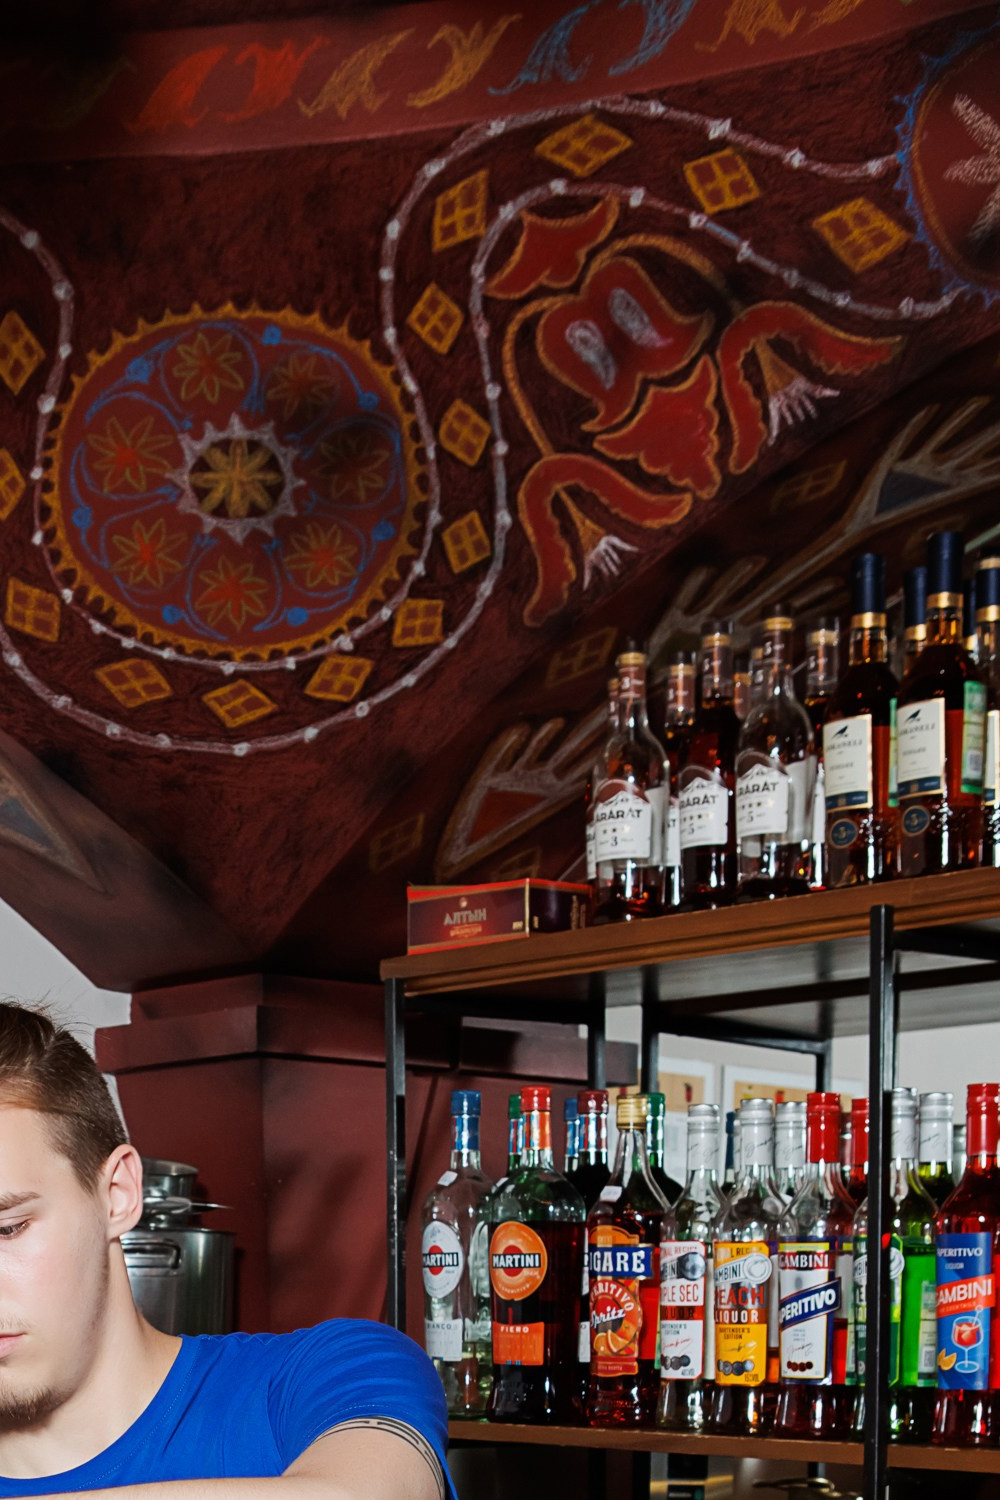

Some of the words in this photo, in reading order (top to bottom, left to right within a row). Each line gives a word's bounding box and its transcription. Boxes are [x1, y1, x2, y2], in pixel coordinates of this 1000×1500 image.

[738, 782, 778, 796] RARAT
[680, 794, 718, 810] RARAT
[610, 835, 618, 847] 3
[492, 1254, 540, 1268] MARTINI
[714, 1263, 741, 1282] AMBINI
[679, 1283, 699, 1302] SEC
[937, 1278, 993, 1306] AMBINI
[780, 1288, 837, 1324] PERITIVO
[715, 1309, 759, 1324] LIQUOR
[500, 1325, 530, 1334] FIERO
